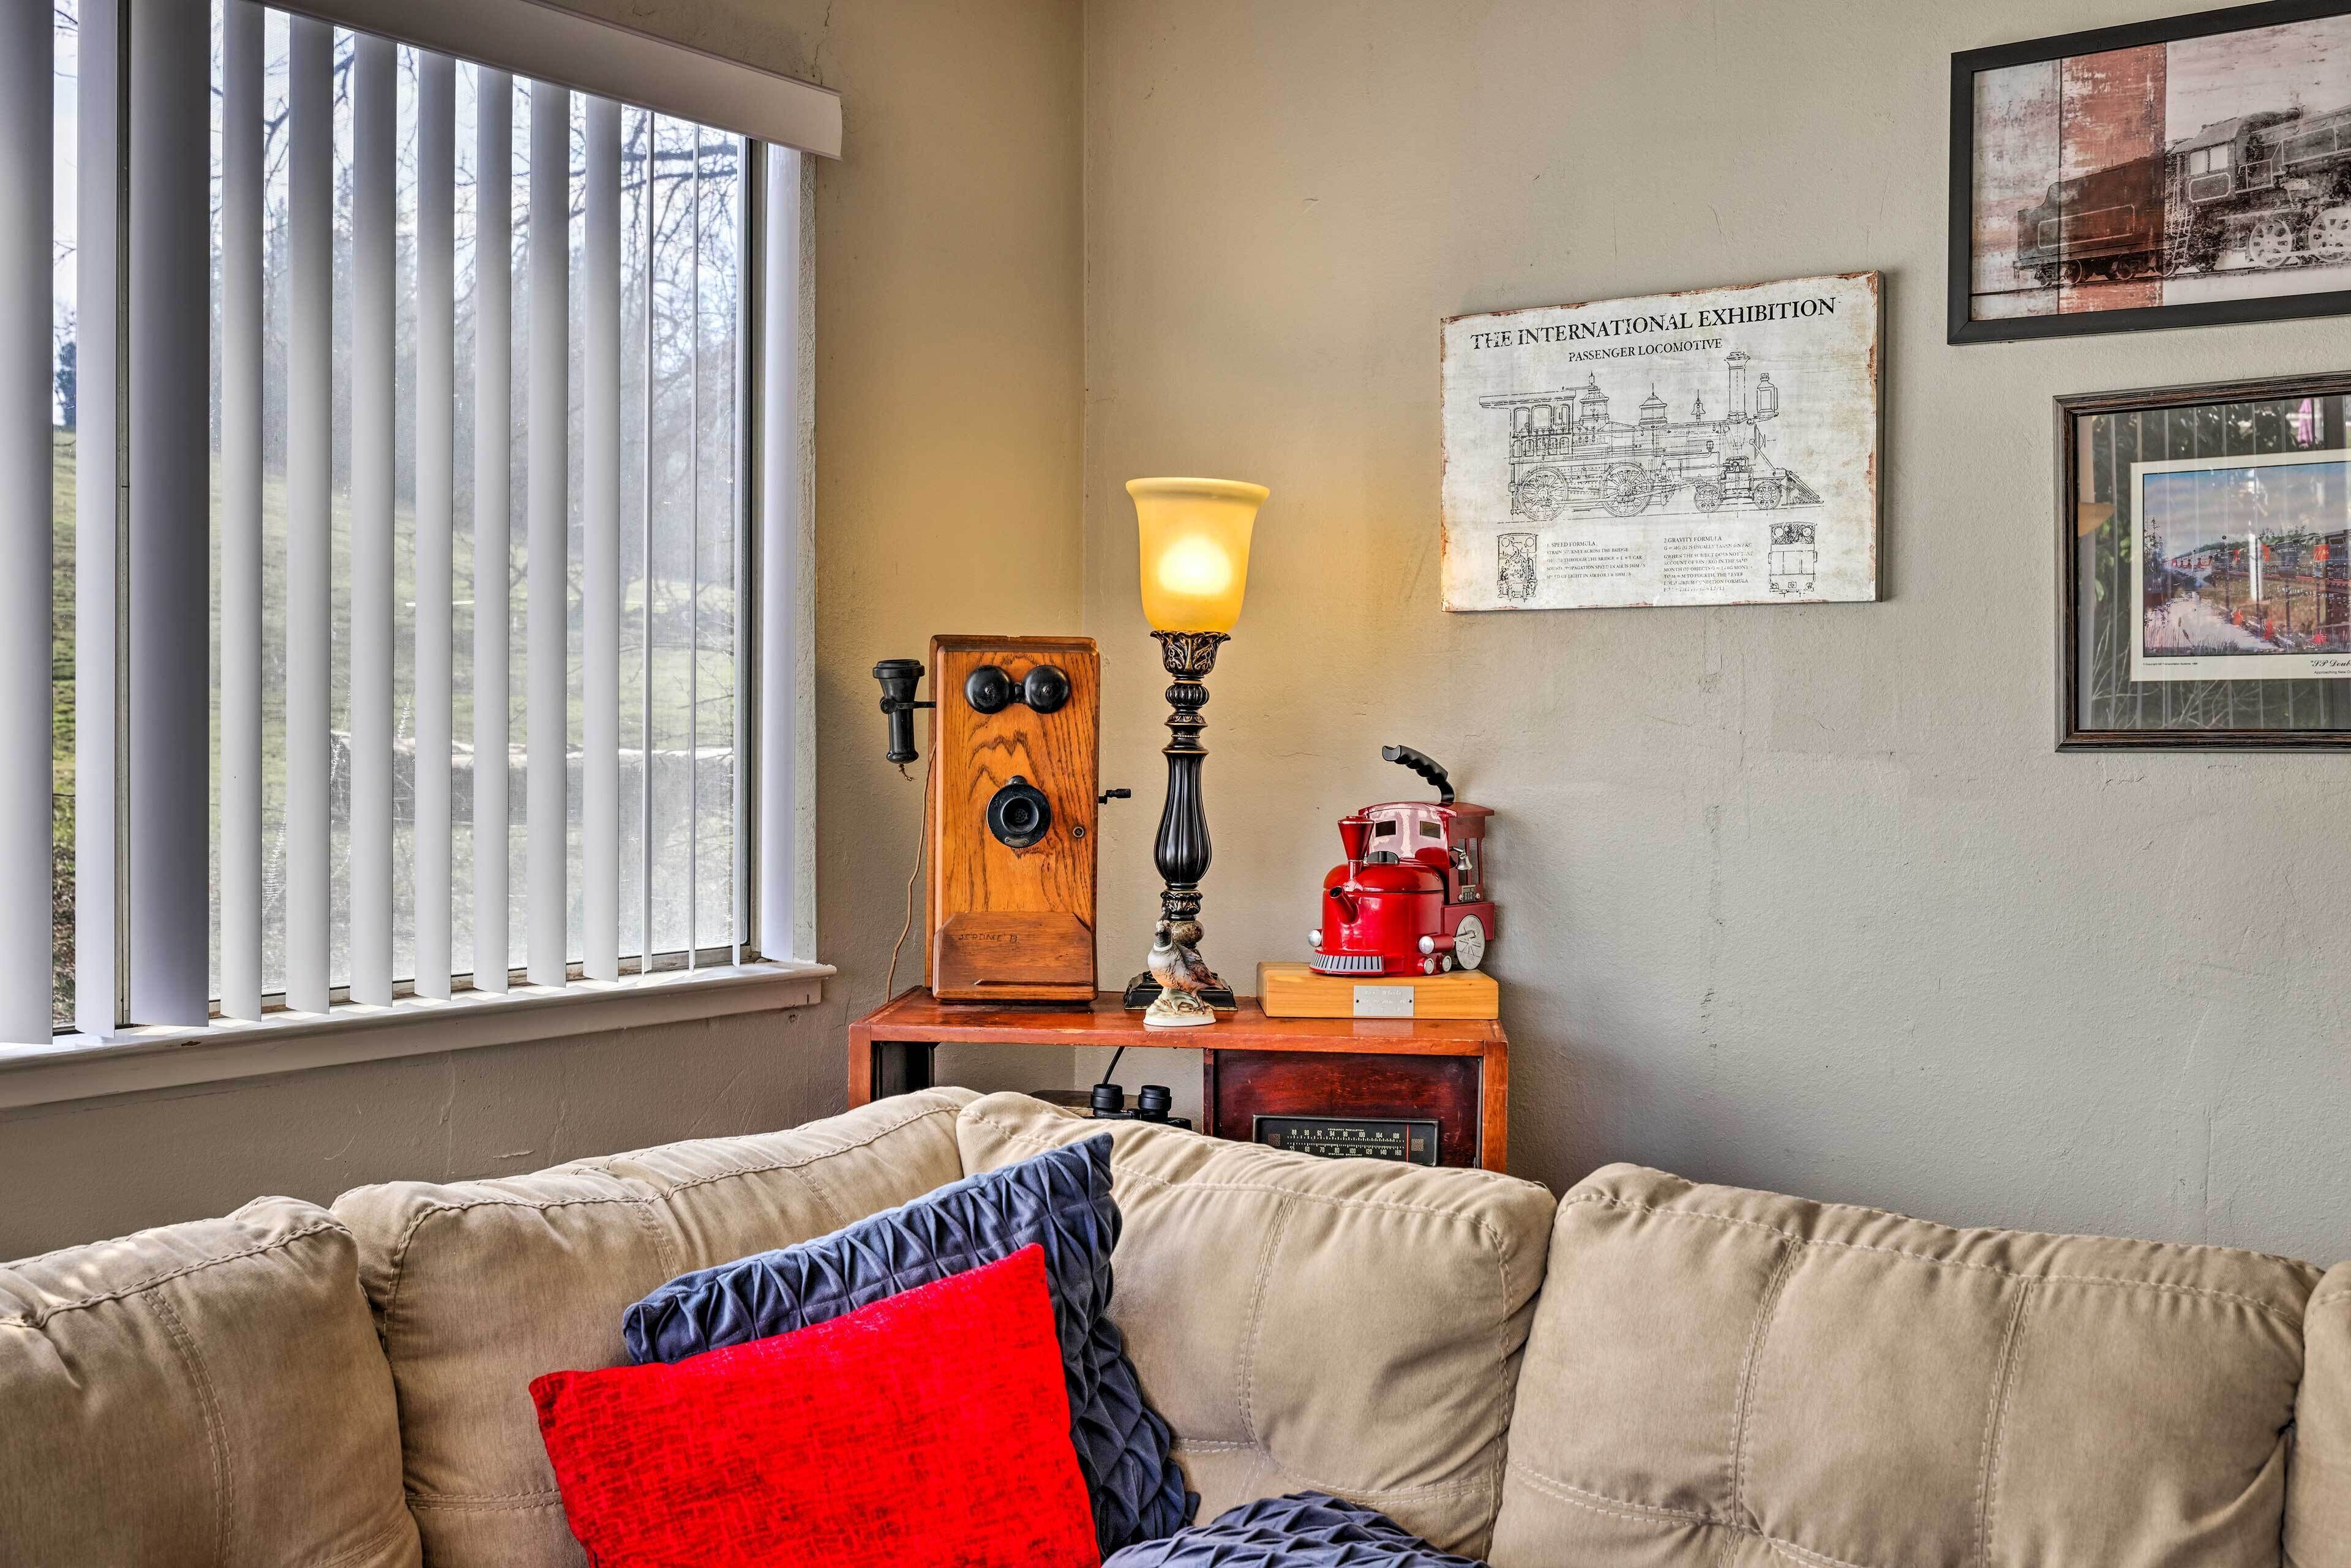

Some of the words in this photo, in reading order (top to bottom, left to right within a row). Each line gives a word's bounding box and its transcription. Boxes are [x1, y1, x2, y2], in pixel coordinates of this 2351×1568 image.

[1470, 331, 1513, 350] THE
[1518, 312, 1693, 345] INTERNATIONAL
[1698, 297, 1836, 328] EXHIBITION
[1569, 347, 1635, 362] PASSENGER
[1638, 338, 1723, 355] LOCOMOTIVE
